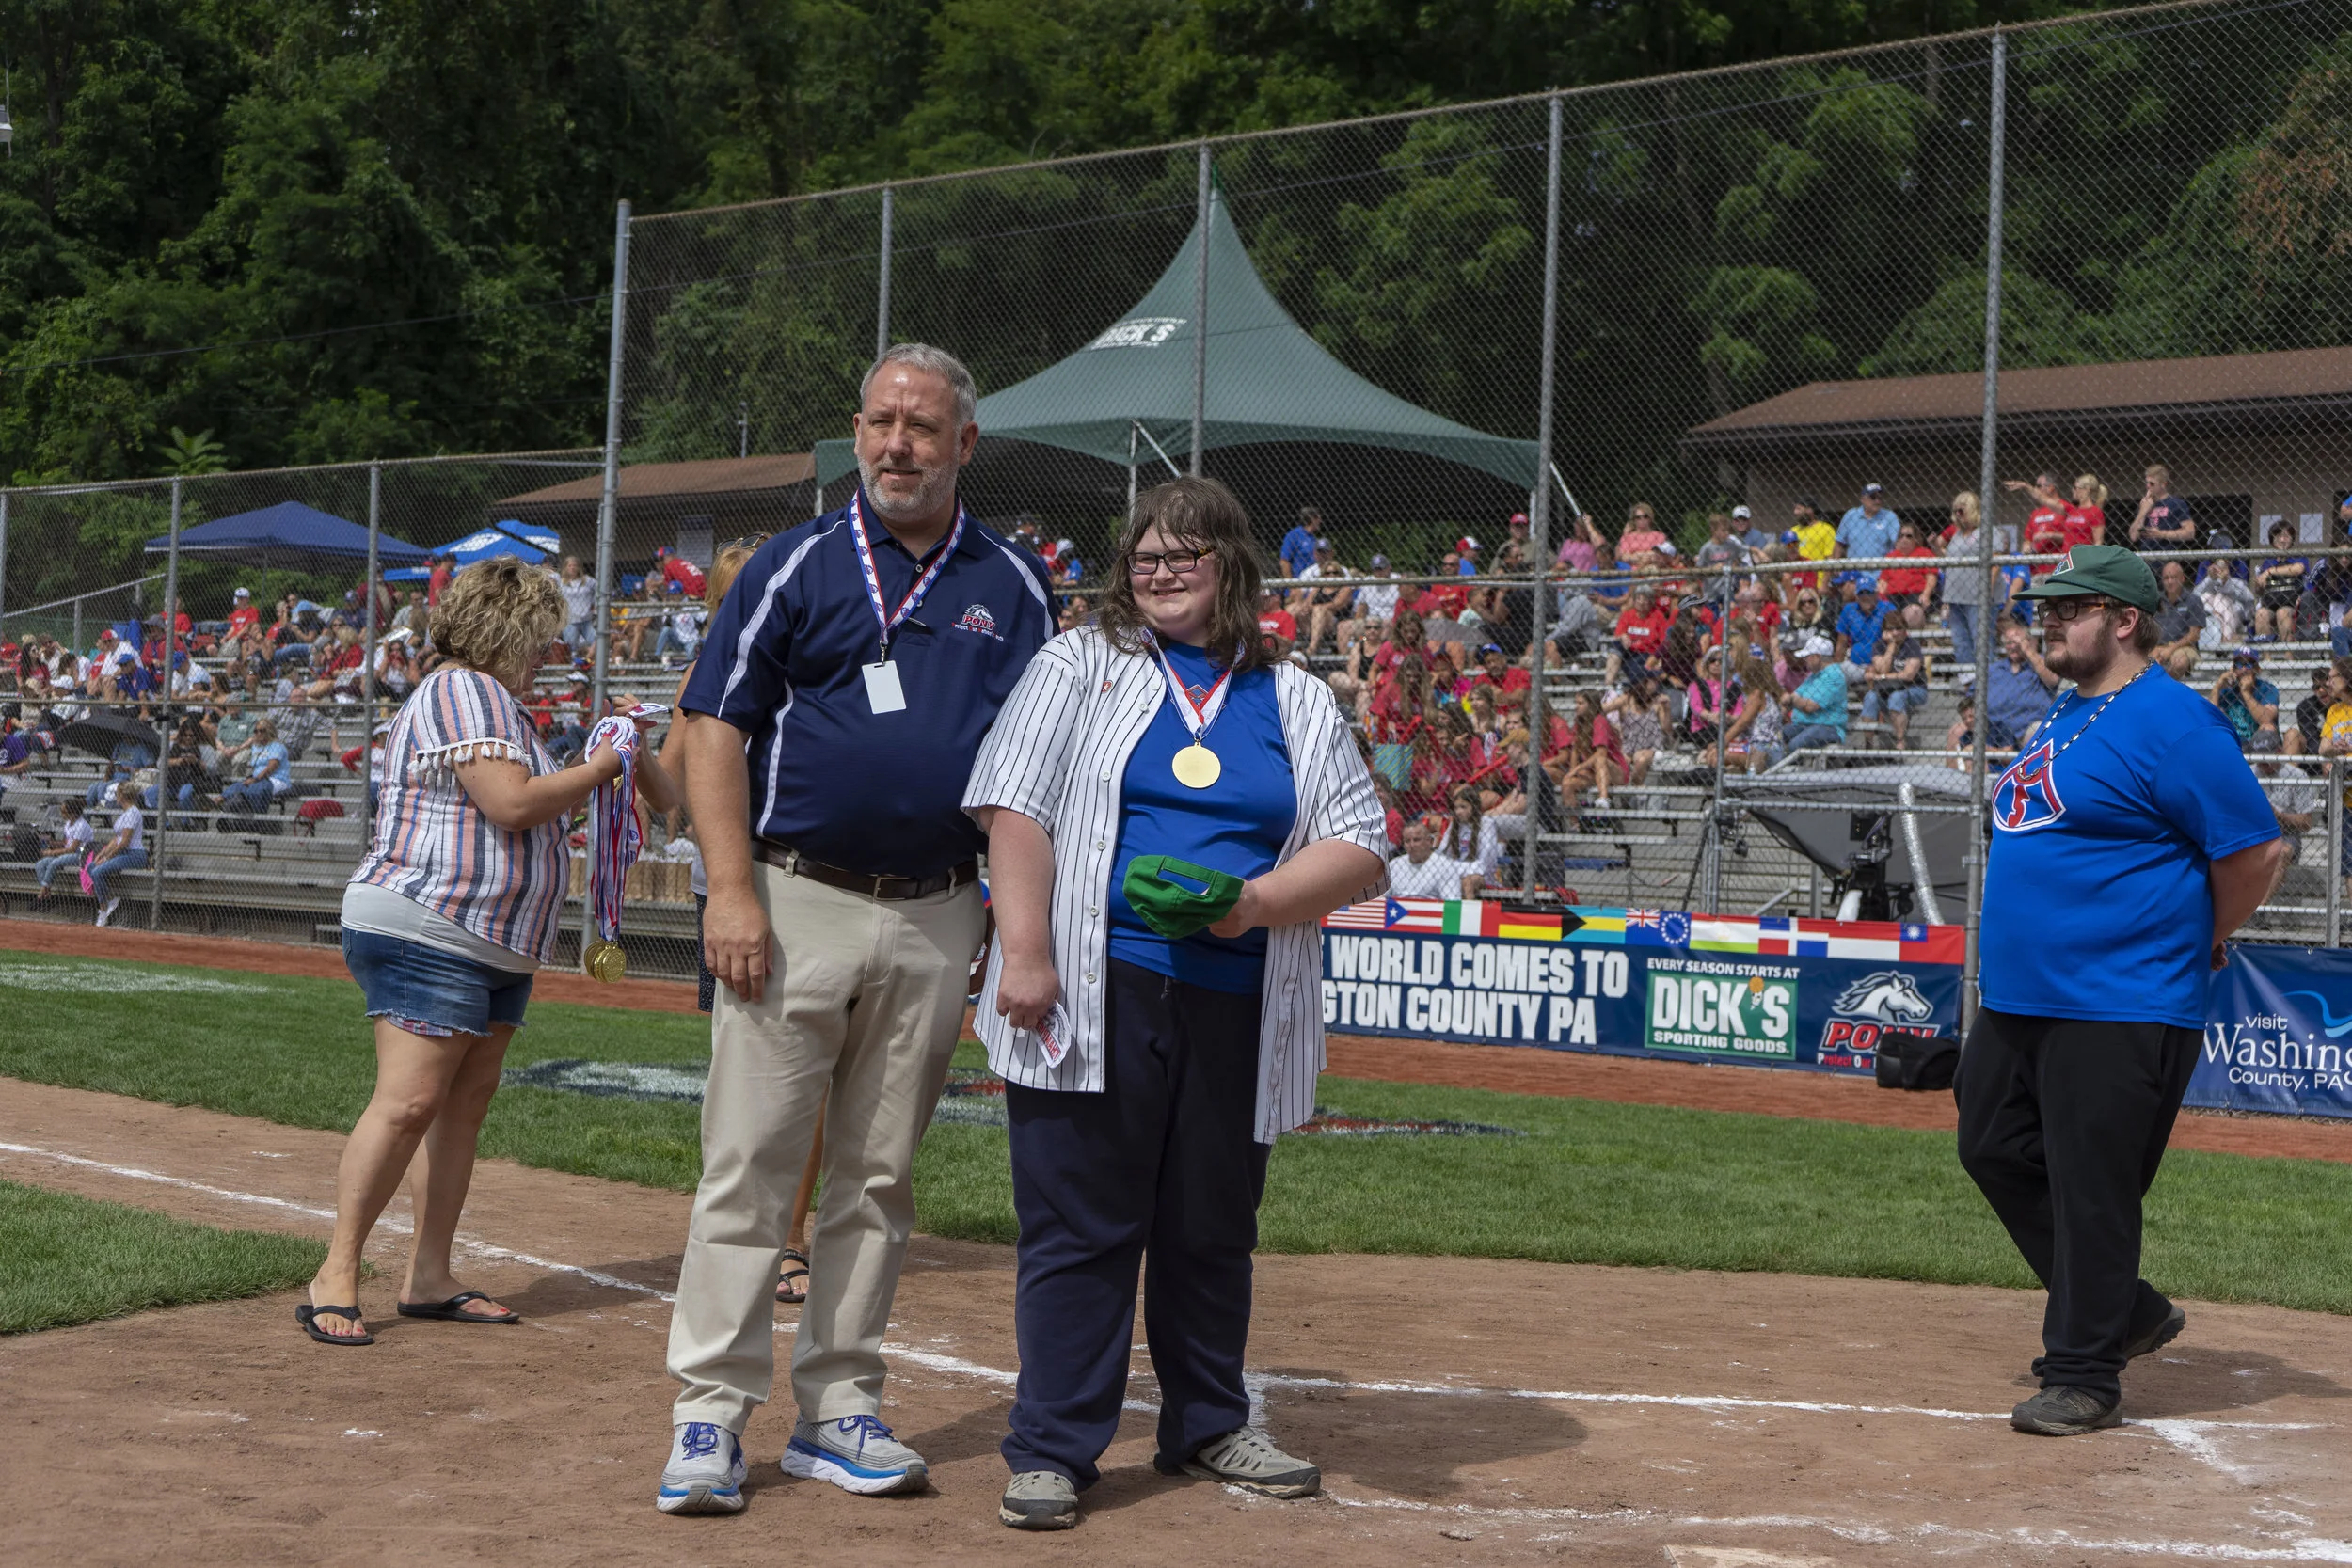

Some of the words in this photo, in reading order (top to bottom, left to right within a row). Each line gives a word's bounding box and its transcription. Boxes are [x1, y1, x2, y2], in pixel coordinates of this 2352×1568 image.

[962, 615, 995, 630] PONY
[1330, 934, 1444, 986] WORLD
[1450, 942, 1575, 994] COMES
[1581, 949, 1629, 998] TO
[1647, 958, 1685, 971] EVERY
[1686, 960, 1735, 975] SEASON
[1736, 964, 1782, 978] STARTS
[1783, 967, 1800, 979] AT
[1406, 987, 1543, 1040] COUNTY
[1548, 996, 1597, 1045] PA
[1652, 976, 1790, 1038] DICK'S
[2245, 1012, 2289, 1031] visit
[1654, 1030, 1728, 1048] SPORTING
[1821, 1019, 1938, 1051] PO
[1817, 1053, 1852, 1068] Protect
[1853, 1055, 1871, 1069] Our
[2228, 1067, 2309, 1093] County,
[2314, 1073, 2344, 1092] PA
